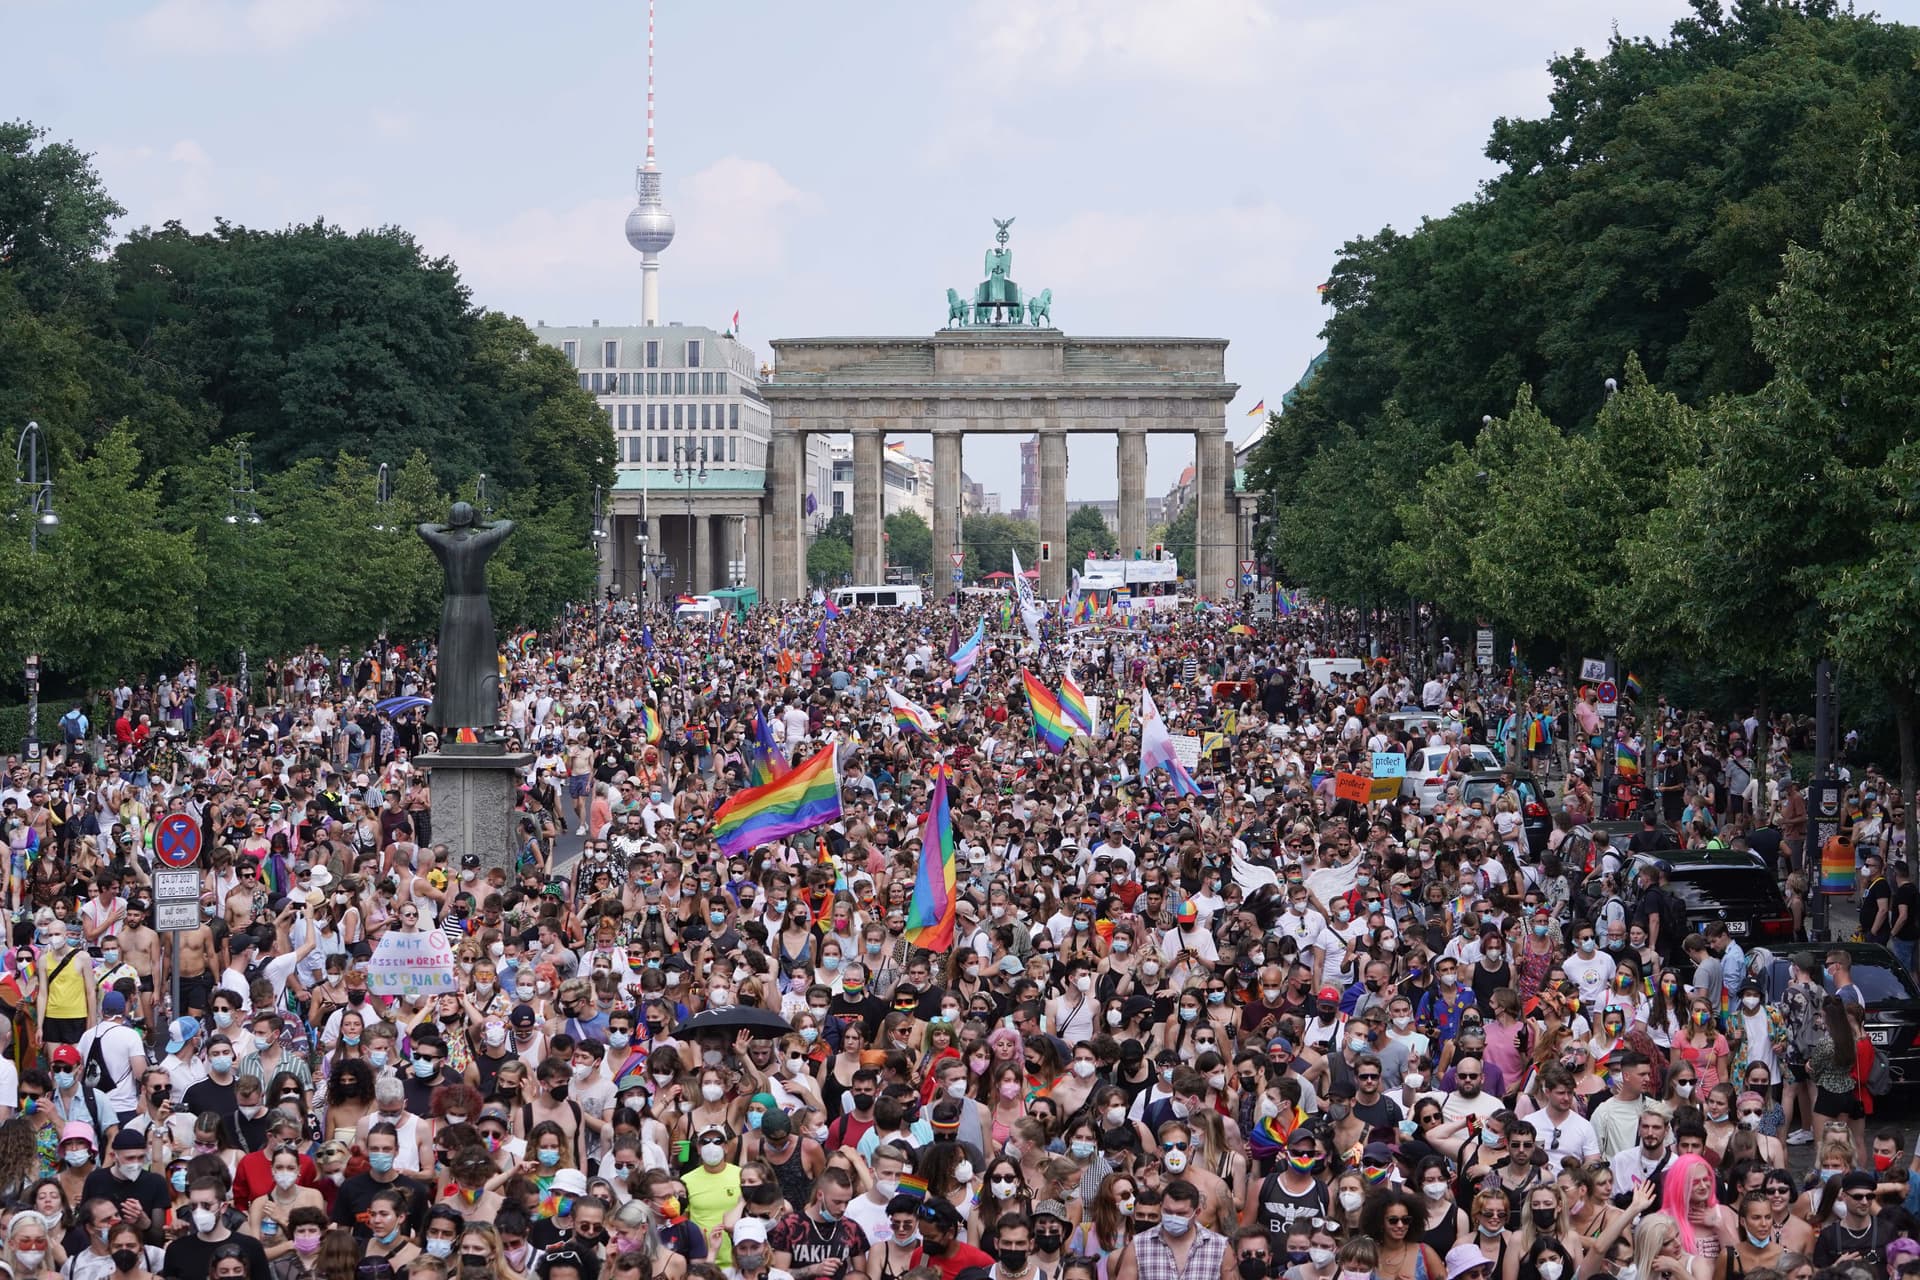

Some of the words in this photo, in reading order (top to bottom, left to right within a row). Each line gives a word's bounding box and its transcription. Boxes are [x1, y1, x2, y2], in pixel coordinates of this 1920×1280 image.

[165, 907, 173, 915] auf
[161, 917, 196, 926] Mittelstreifen
[1733, 922, 1743, 930] 52
[397, 940, 421, 949] MIT
[368, 973, 452, 987] BOLSONARO
[1872, 1032, 1883, 1042] 25
[791, 1244, 850, 1262] YAKUA
